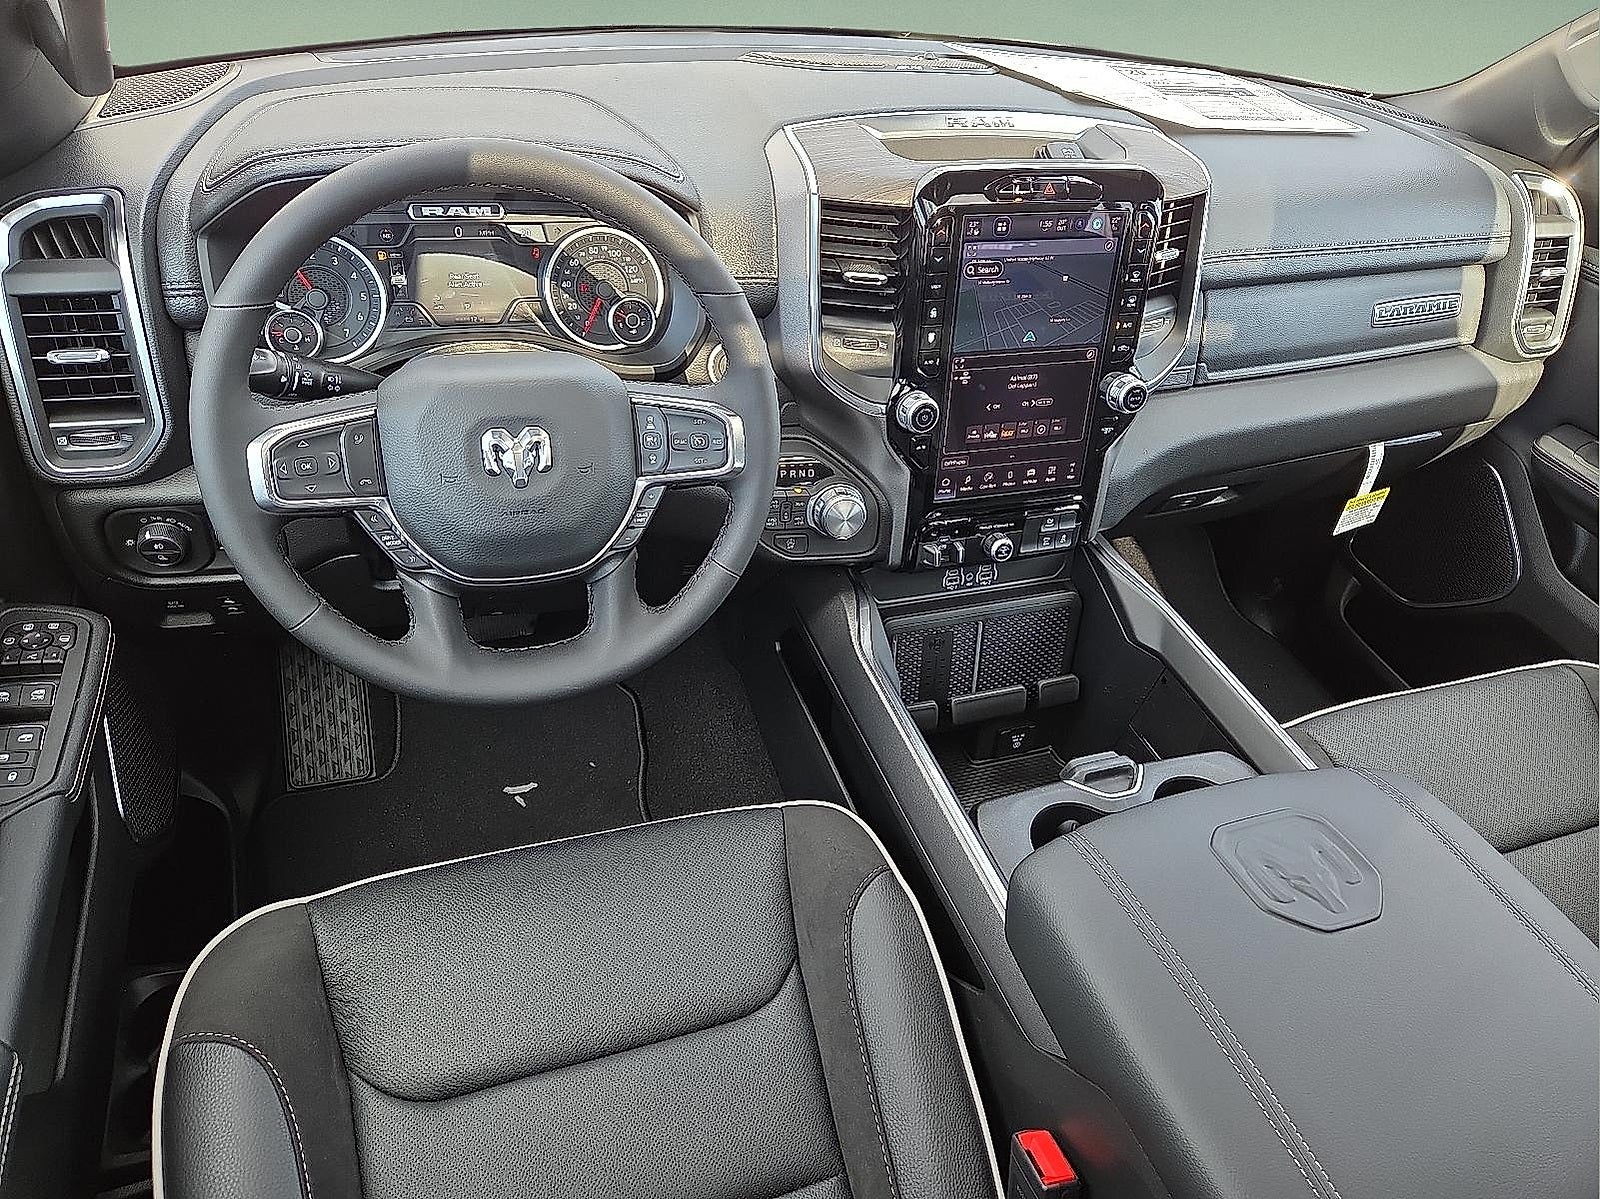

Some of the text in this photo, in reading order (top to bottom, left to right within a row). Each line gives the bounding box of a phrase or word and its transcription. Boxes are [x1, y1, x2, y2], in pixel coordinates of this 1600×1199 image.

[945, 116, 1015, 128] RAM
[421, 206, 496, 217] RAM
[1040, 219, 1053, 228] 1:55
[454, 226, 464, 238] 0
[588, 246, 599, 255] 80
[608, 250, 622, 258] 100
[331, 256, 339, 266] 3
[569, 258, 580, 267] 60
[625, 265, 639, 274] 120
[977, 266, 999, 274] Search
[350, 271, 358, 281] 4
[561, 280, 572, 288] 40
[360, 292, 367, 301] 5
[567, 302, 578, 310] 20
[1375, 300, 1459, 319] LARAMIE
[357, 312, 364, 322] 6
[343, 328, 350, 338] 7
[300, 462, 313, 471] OK
[780, 469, 815, 479] P R N D
[176, 521, 193, 532] AUTO
